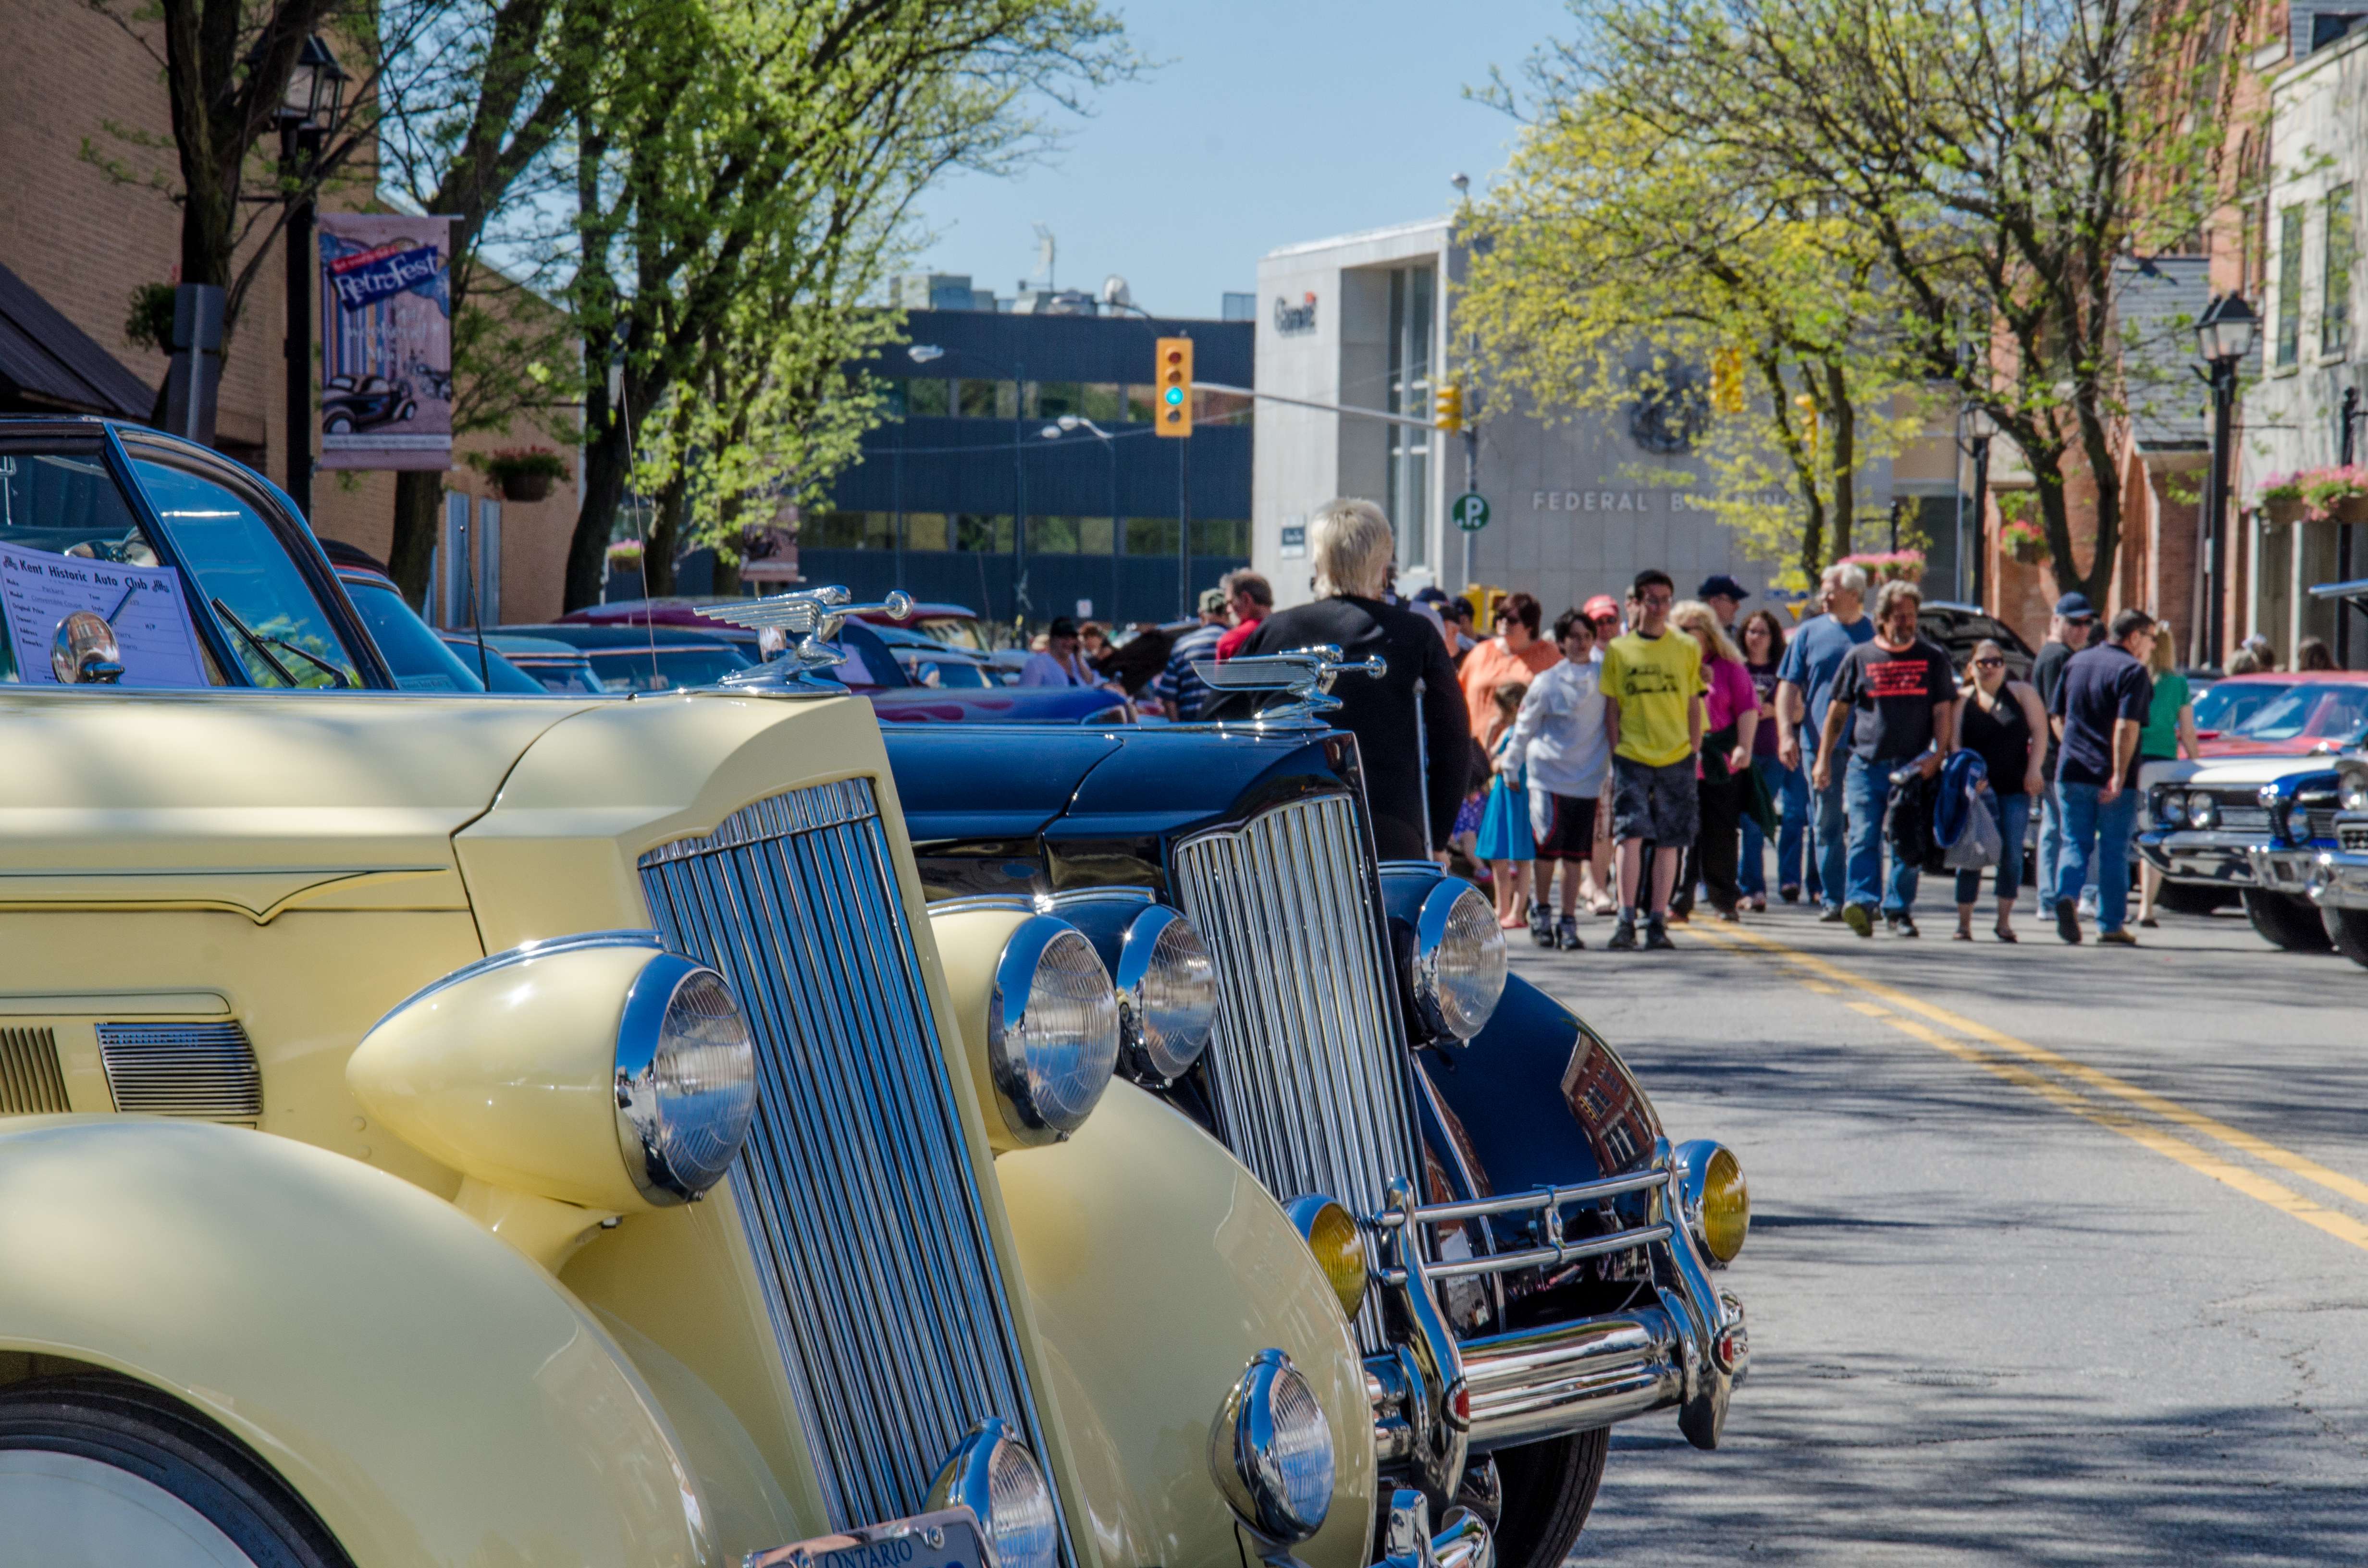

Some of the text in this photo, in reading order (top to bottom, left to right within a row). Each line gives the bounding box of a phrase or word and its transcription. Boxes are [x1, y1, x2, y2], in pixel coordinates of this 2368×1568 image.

[334, 251, 438, 304] RetroFest
[1465, 497, 1484, 527] P
[1533, 491, 1647, 512] FEDERAL
[19, 559, 43, 575] Kent
[48, 565, 87, 582] Historic
[94, 573, 118, 586] Auto
[124, 577, 147, 590] Club
[825, 1539, 912, 1568] ONTARIO
